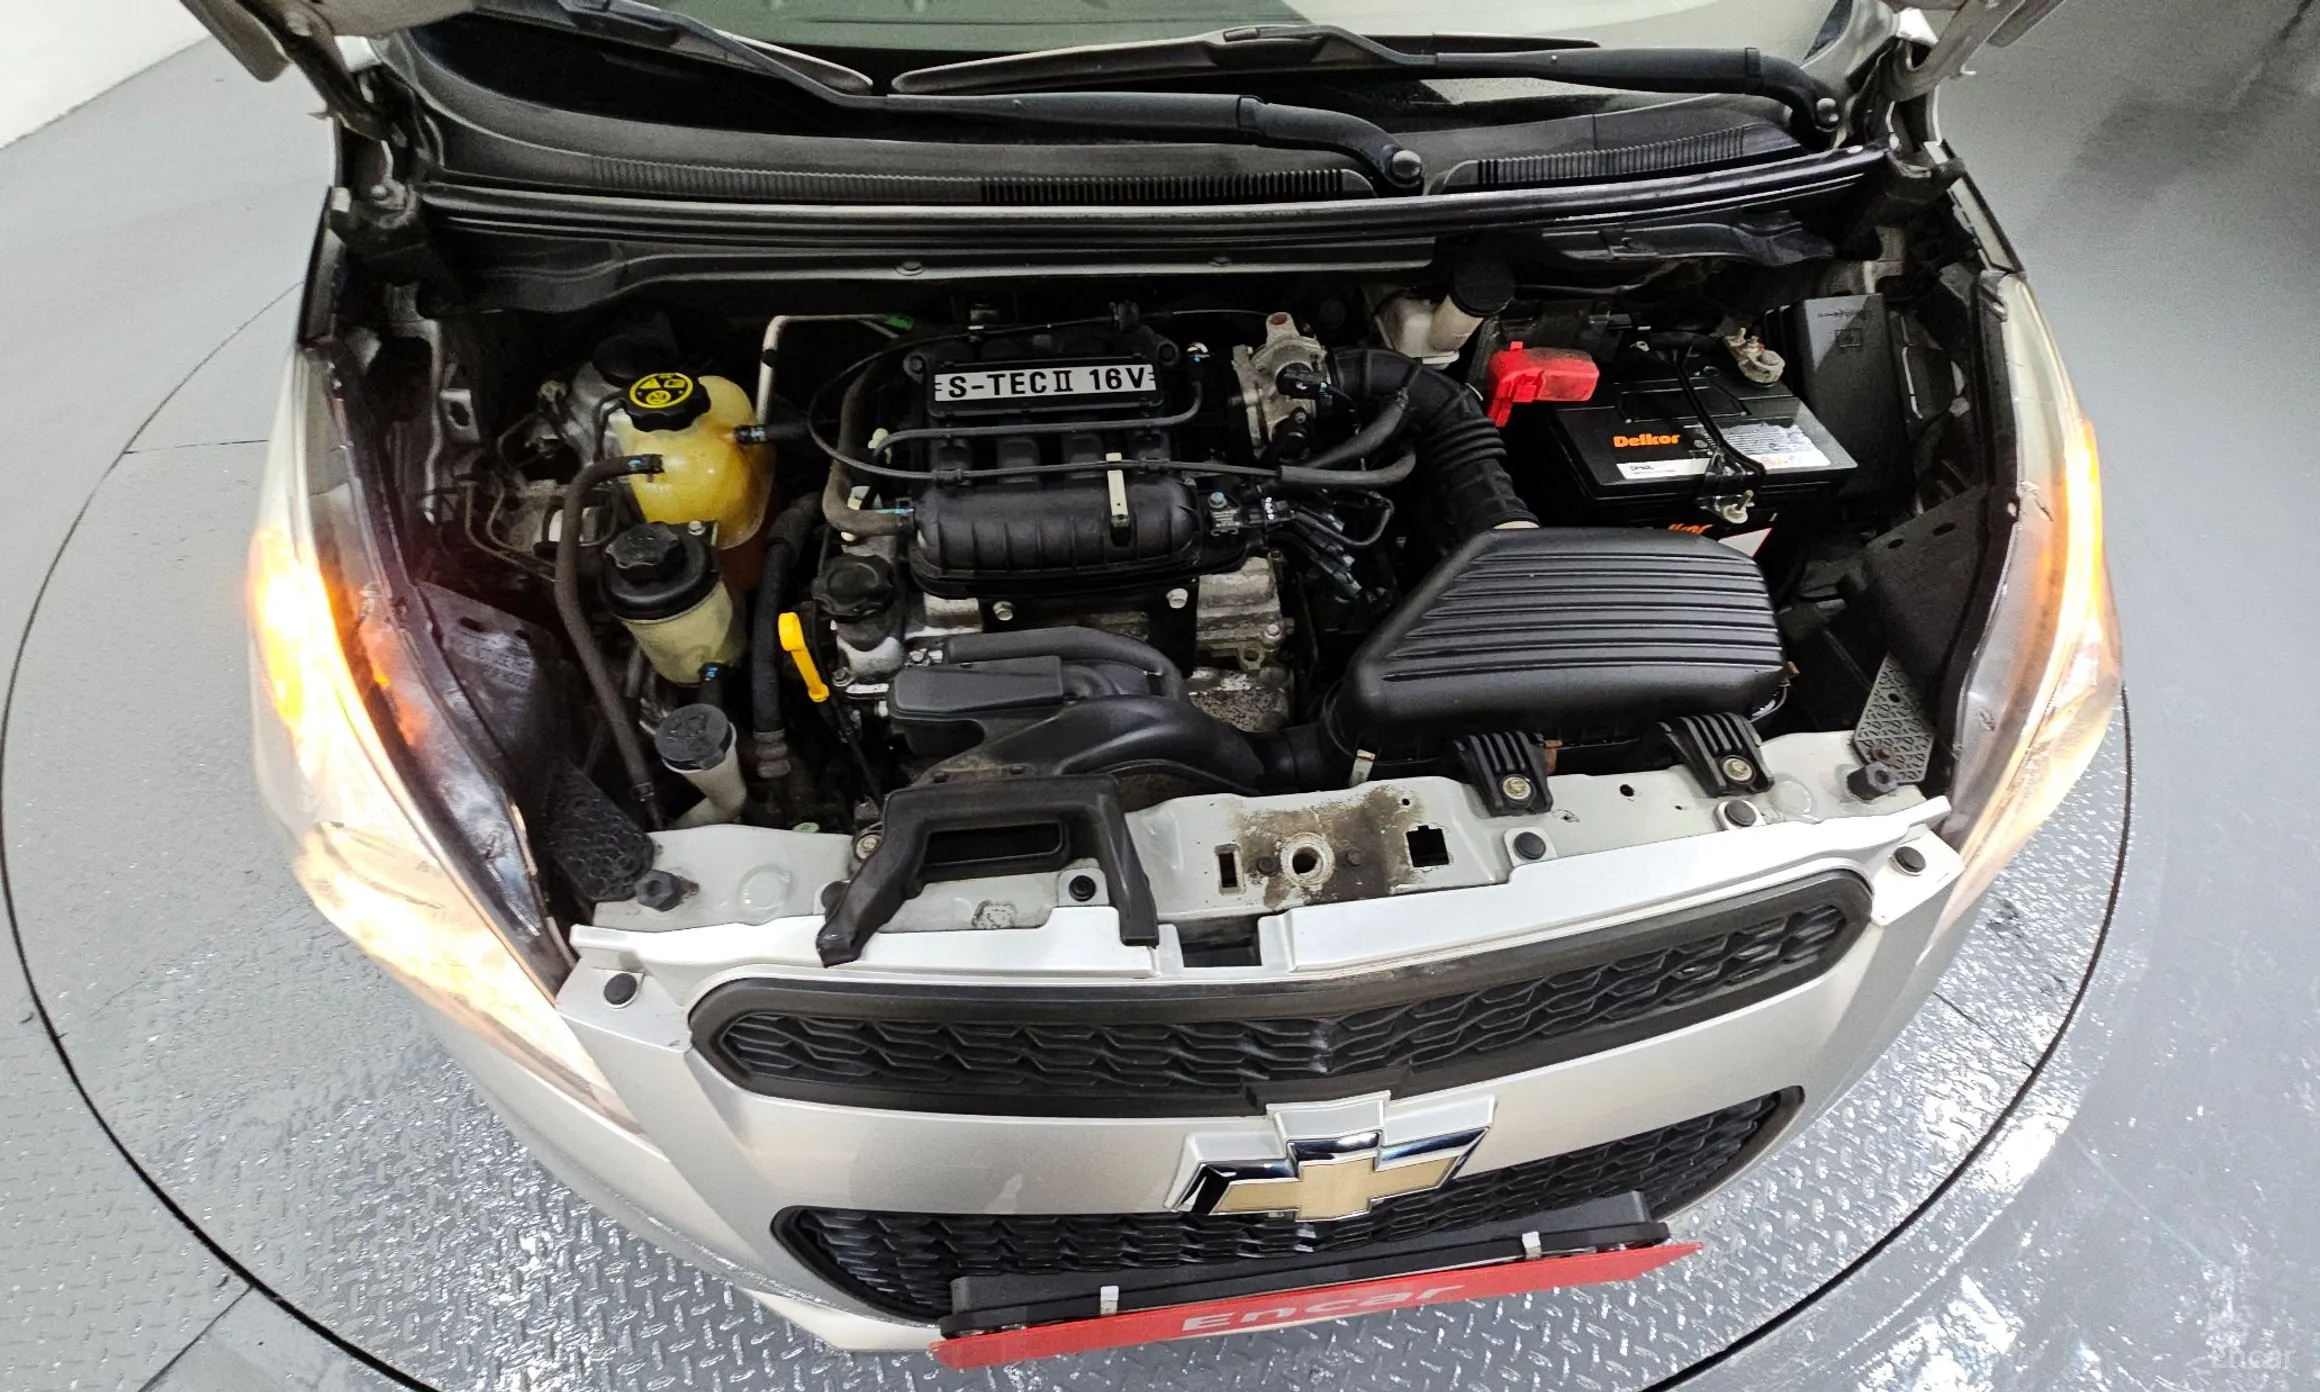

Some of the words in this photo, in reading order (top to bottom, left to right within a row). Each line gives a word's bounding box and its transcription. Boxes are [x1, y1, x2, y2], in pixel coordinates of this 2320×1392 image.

[1089, 367, 1146, 391] 16V
[1613, 433, 1681, 448] Delkor
[1181, 1285, 1466, 1332] Encar
